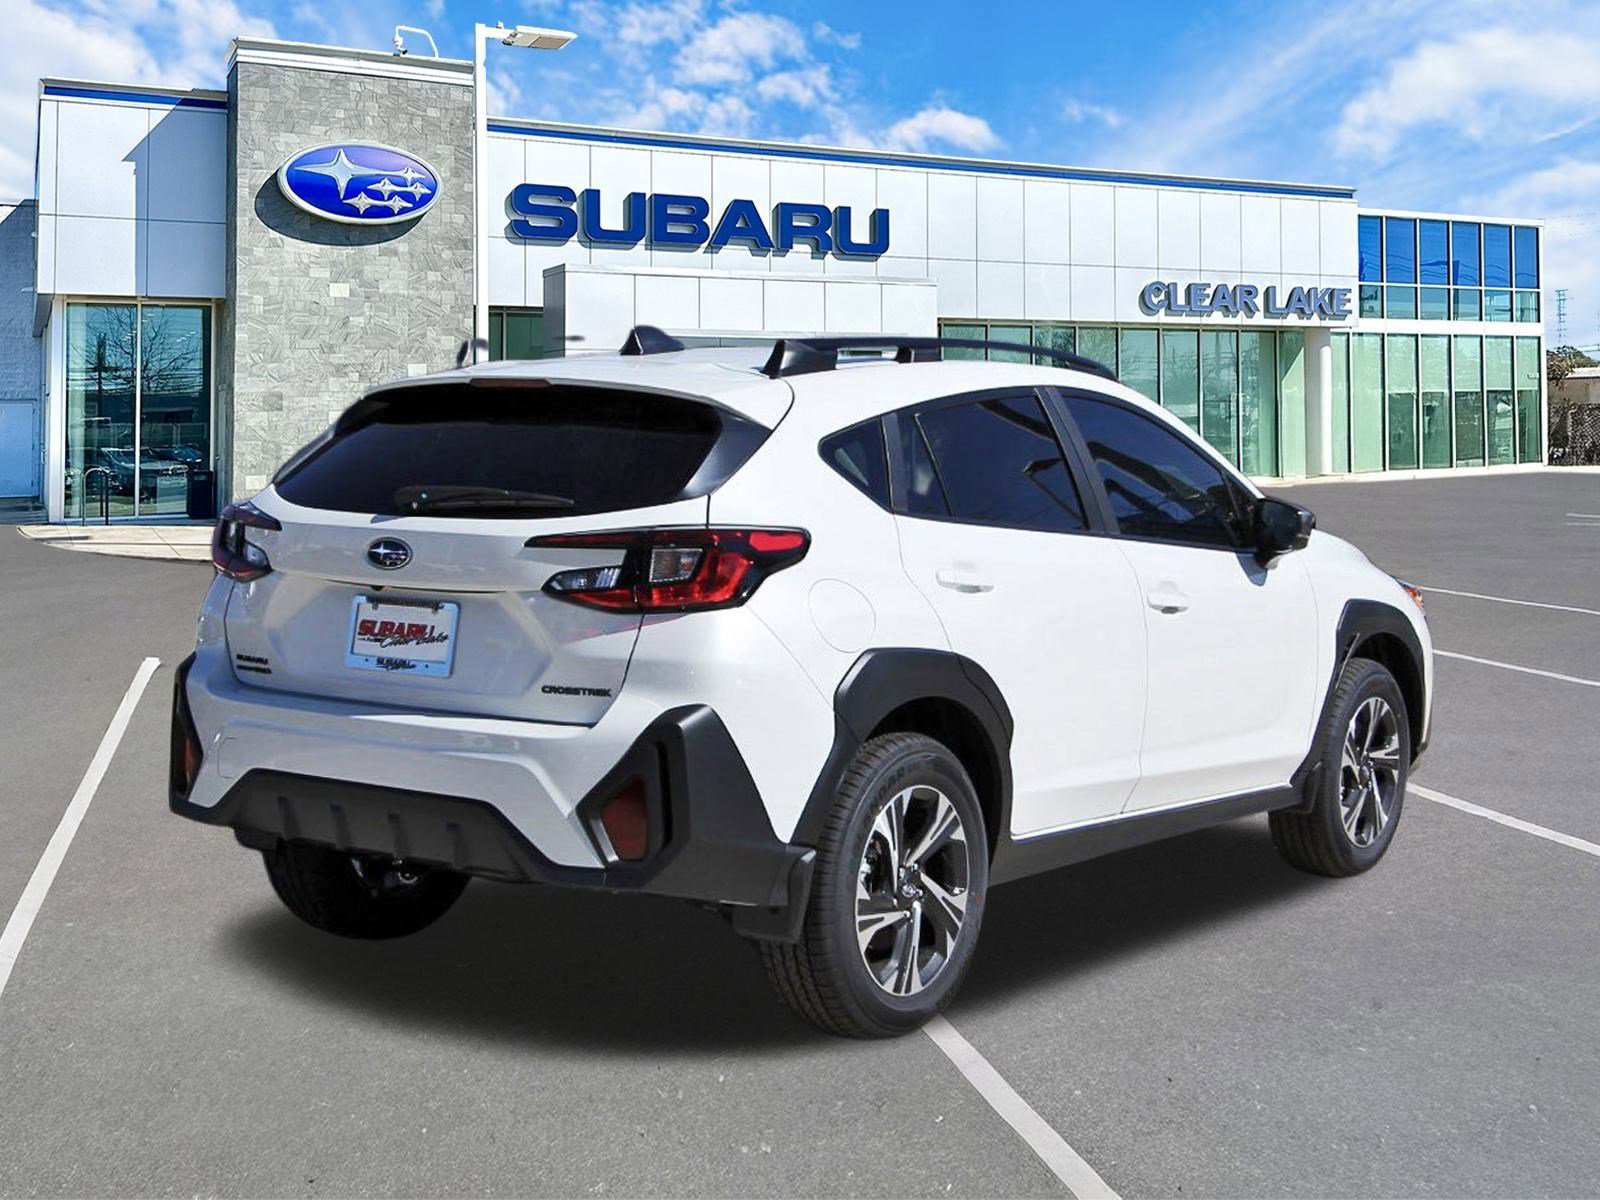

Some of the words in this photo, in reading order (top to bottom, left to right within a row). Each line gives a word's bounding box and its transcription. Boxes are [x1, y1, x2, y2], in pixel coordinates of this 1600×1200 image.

[506, 183, 889, 259] SUBARU
[1140, 281, 1260, 317] CLEAR
[1264, 286, 1352, 319] LAKE
[358, 619, 435, 639] SUBARU
[541, 685, 612, 697] CROSSTREK
